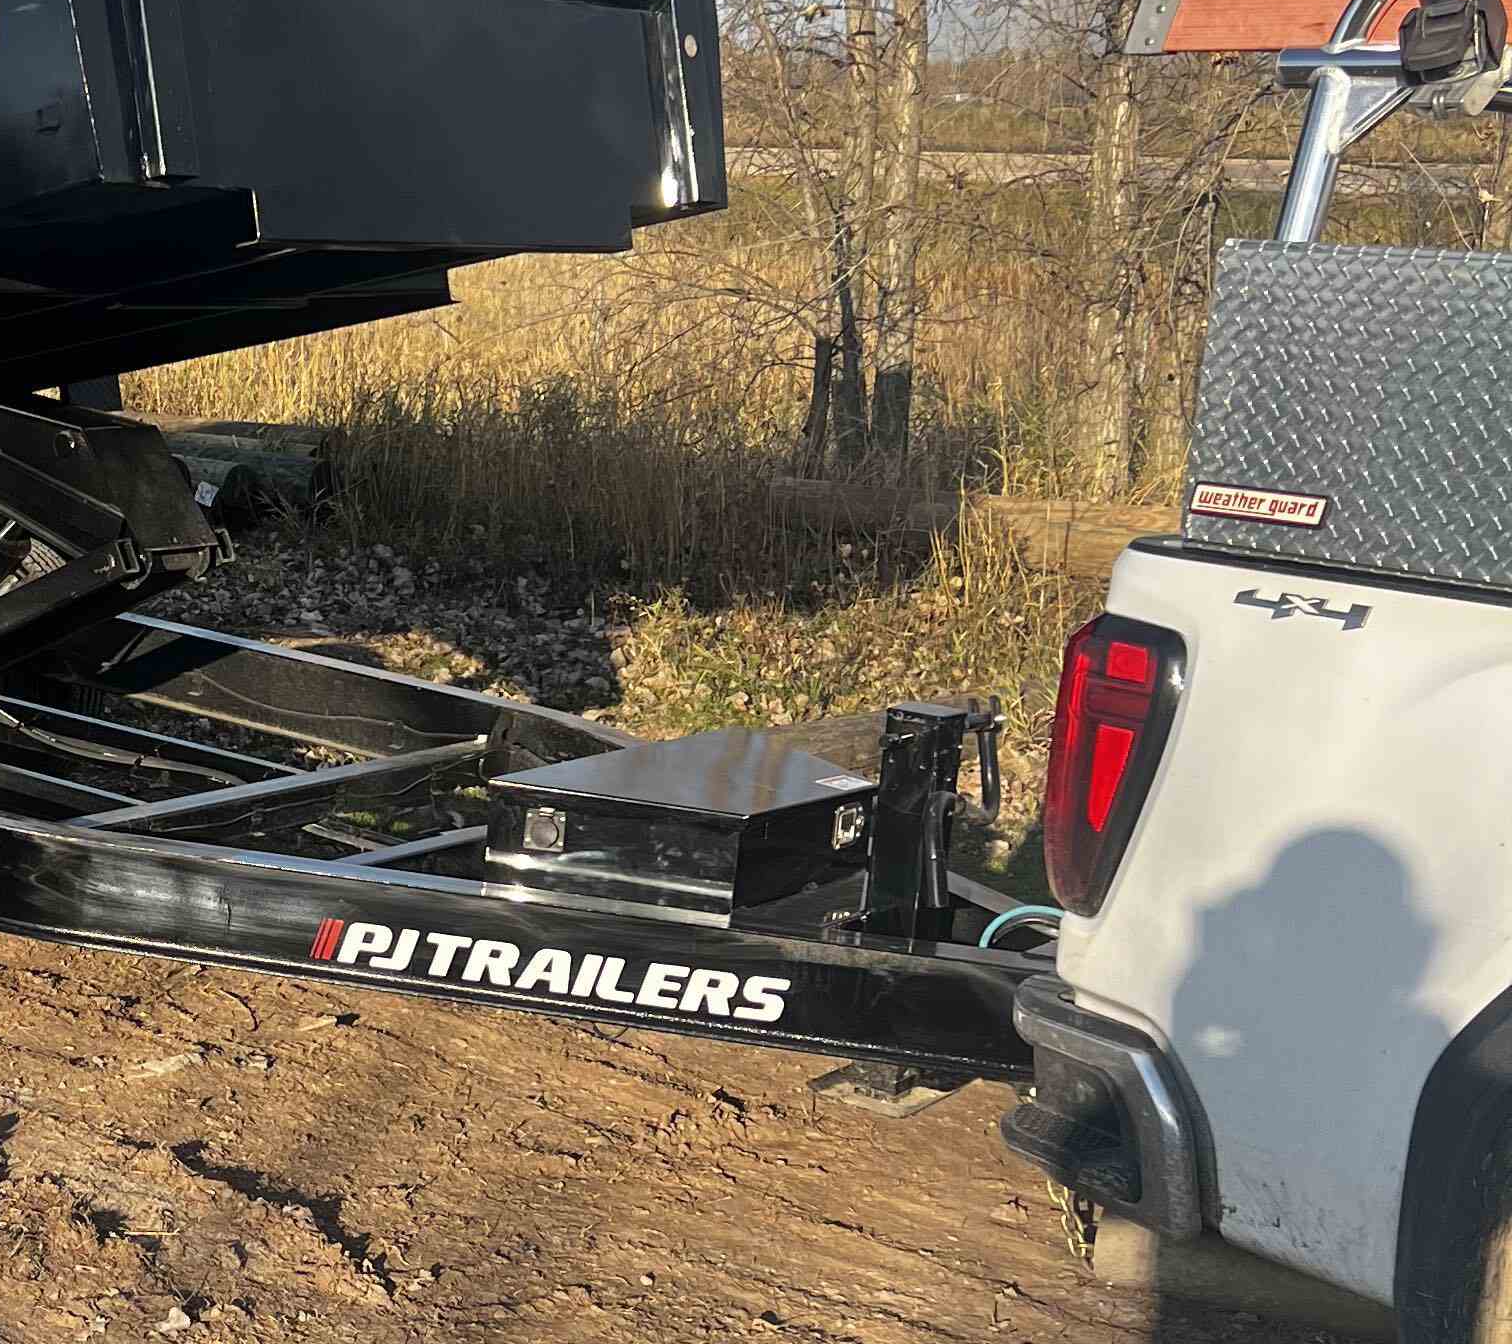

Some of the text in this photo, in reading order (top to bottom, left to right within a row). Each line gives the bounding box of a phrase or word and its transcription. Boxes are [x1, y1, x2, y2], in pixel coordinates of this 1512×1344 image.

[1198, 489, 1319, 517] weather guard
[337, 922, 792, 1024] PJ TRAILERS
